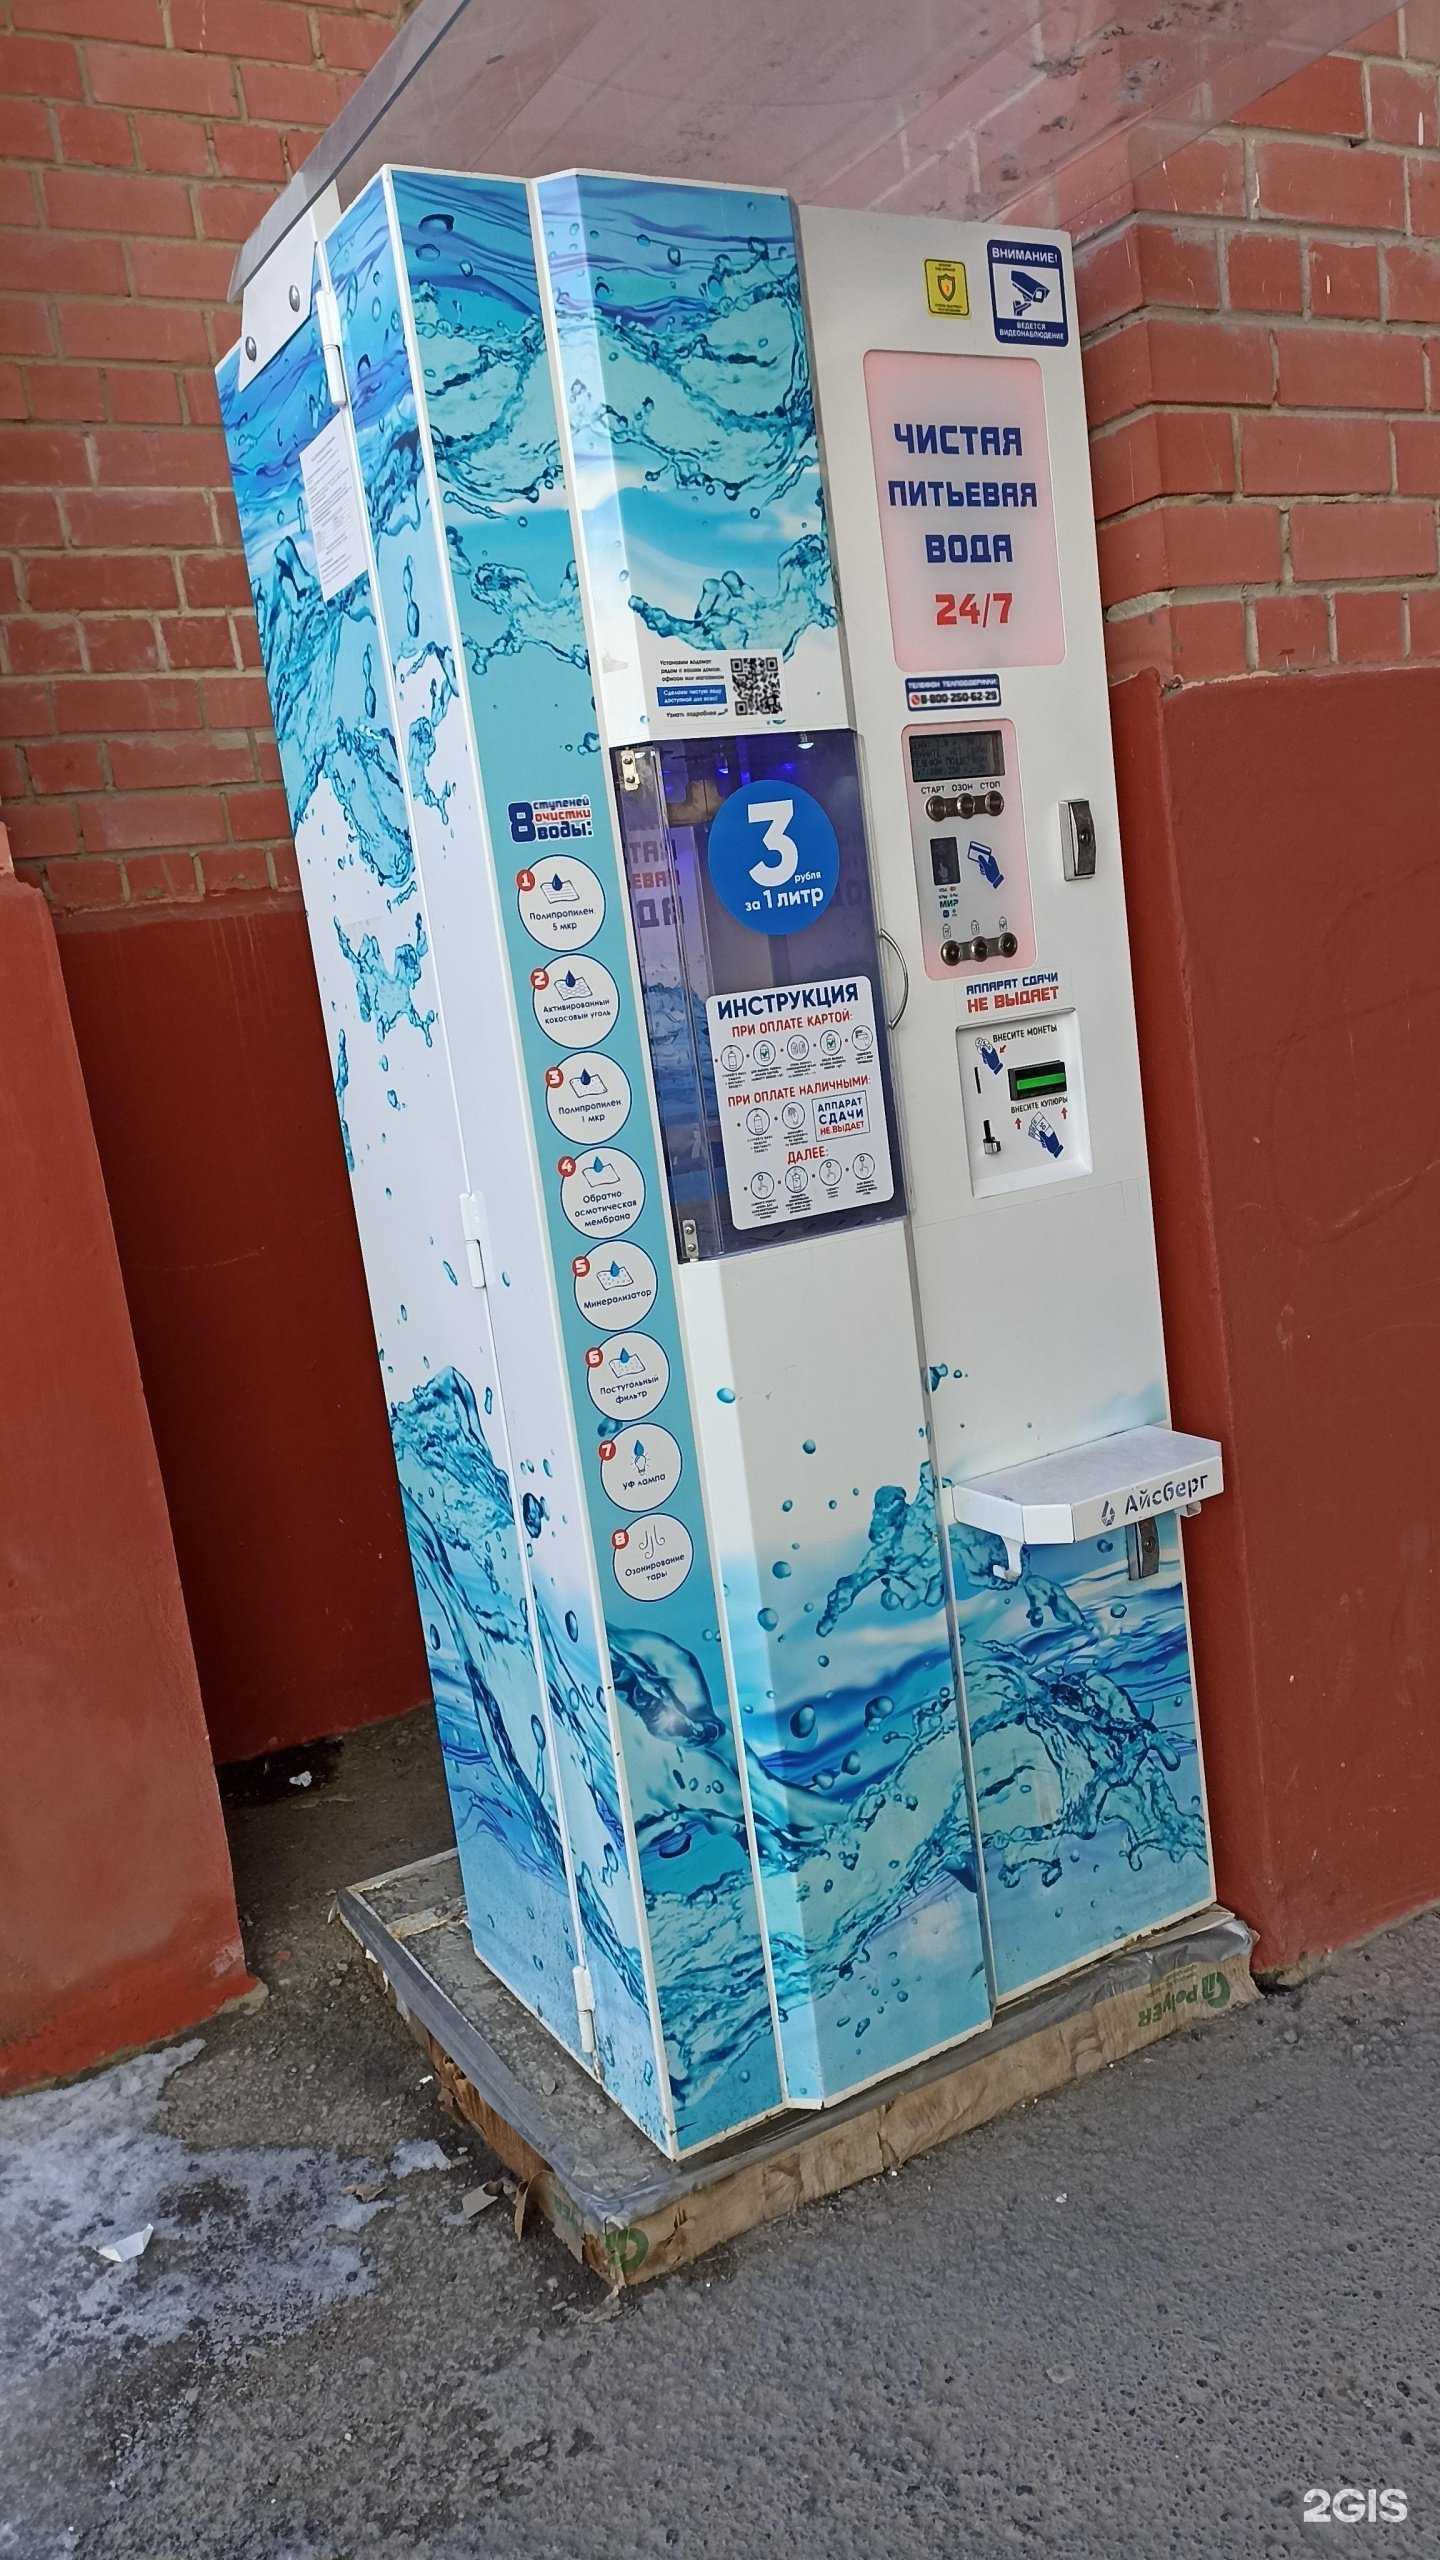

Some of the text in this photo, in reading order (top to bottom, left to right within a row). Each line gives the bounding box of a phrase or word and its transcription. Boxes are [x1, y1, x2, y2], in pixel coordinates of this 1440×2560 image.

[992, 247, 1058, 263] ВНИМАНИЕ!
[1017, 322, 1046, 330] ВЕДЕТСЯ
[1000, 329, 1064, 340] ВИДЕОНАБЛЮДЕНИЕ
[894, 422, 1022, 456] ЧИСТАЯ
[888, 480, 1037, 508] ПИТЬЕВАЯ
[925, 534, 1013, 563] ВОДА
[935, 592, 1013, 629] 24/7
[921, 780, 1000, 794] СТАРТ ОЗОН СТОП
[509, 796, 590, 842] 8 ступеней
[535, 809, 591, 822] очистки
[537, 821, 593, 840] воды:
[748, 799, 798, 886] 3
[794, 871, 821, 883] рубля
[745, 887, 823, 912] за 1 литр
[940, 899, 958, 908] МИР
[530, 908, 594, 920] Полипропилен
[553, 922, 577, 931] 5 мкр
[534, 972, 546, 988] 2
[966, 972, 1058, 995] АППАРАТ СДАЧИ
[543, 998, 610, 1013] Активированный
[718, 982, 859, 1020] ИНСТРУКЦИЯ
[967, 986, 1059, 1013] НЕ ВЫДАЕТ
[545, 1010, 611, 1024] кокосовый уголь
[732, 1009, 853, 1038] ПРИ ОПЛАТЕ КАРТОЙ:
[993, 1024, 1058, 1043] ВНЕСИТЕ МОНЕТЫ
[549, 1070, 560, 1085] 3
[728, 1075, 871, 1107] ПРИ ОПЛАТЕ НАЛИЧНЫМИ:
[558, 1099, 622, 1115] Полипропилен
[818, 1097, 862, 1113] АППАРАТ
[1011, 1096, 1068, 1114] ВНЕСИТЕ КУПЮРЫ
[588, 1114, 605, 1123] мкр
[819, 1108, 864, 1125] СДАЧИ
[820, 1121, 865, 1135] НЕ ВЫДАЕТ
[787, 1145, 828, 1165] ДАЛЕЕ:
[561, 1159, 573, 1173] 4
[575, 1200, 637, 1218] осмотическая
[584, 1212, 631, 1227] мембрана
[575, 1259, 587, 1274] 5
[584, 1289, 652, 1309] Минерализатор
[589, 1350, 600, 1365] 6
[600, 1376, 660, 1395] Постугольный
[615, 1390, 648, 1405] фильтр
[603, 1443, 613, 1458] 7
[637, 1473, 666, 1487] лампа
[1125, 1474, 1208, 1515] Айсберг
[615, 1532, 626, 1546] 8
[625, 1554, 685, 1577] Озонирование
[646, 1572, 668, 1583] тары
